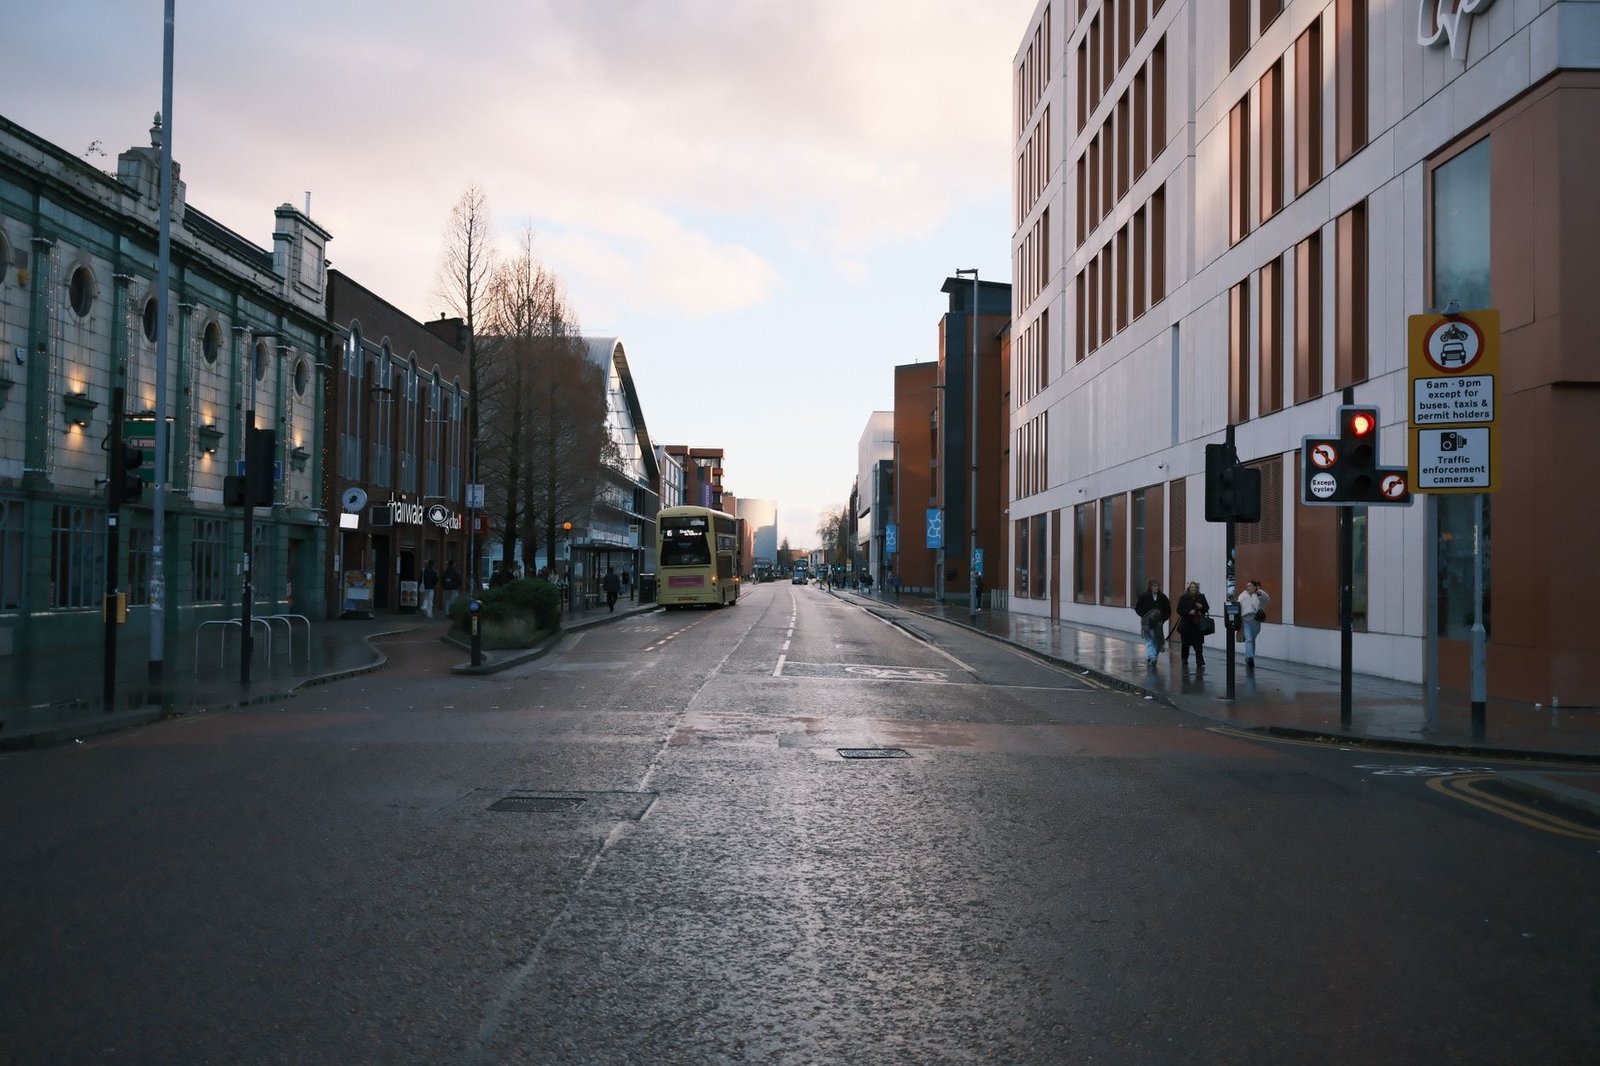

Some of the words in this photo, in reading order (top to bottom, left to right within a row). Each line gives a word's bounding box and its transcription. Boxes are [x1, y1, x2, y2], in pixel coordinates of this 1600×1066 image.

[1458, 380, 1481, 388] 9pm
[1428, 390, 1461, 398] except
[1455, 400, 1478, 408] taxis
[1418, 412, 1450, 421] permit
[1423, 465, 1485, 473] enforcement
